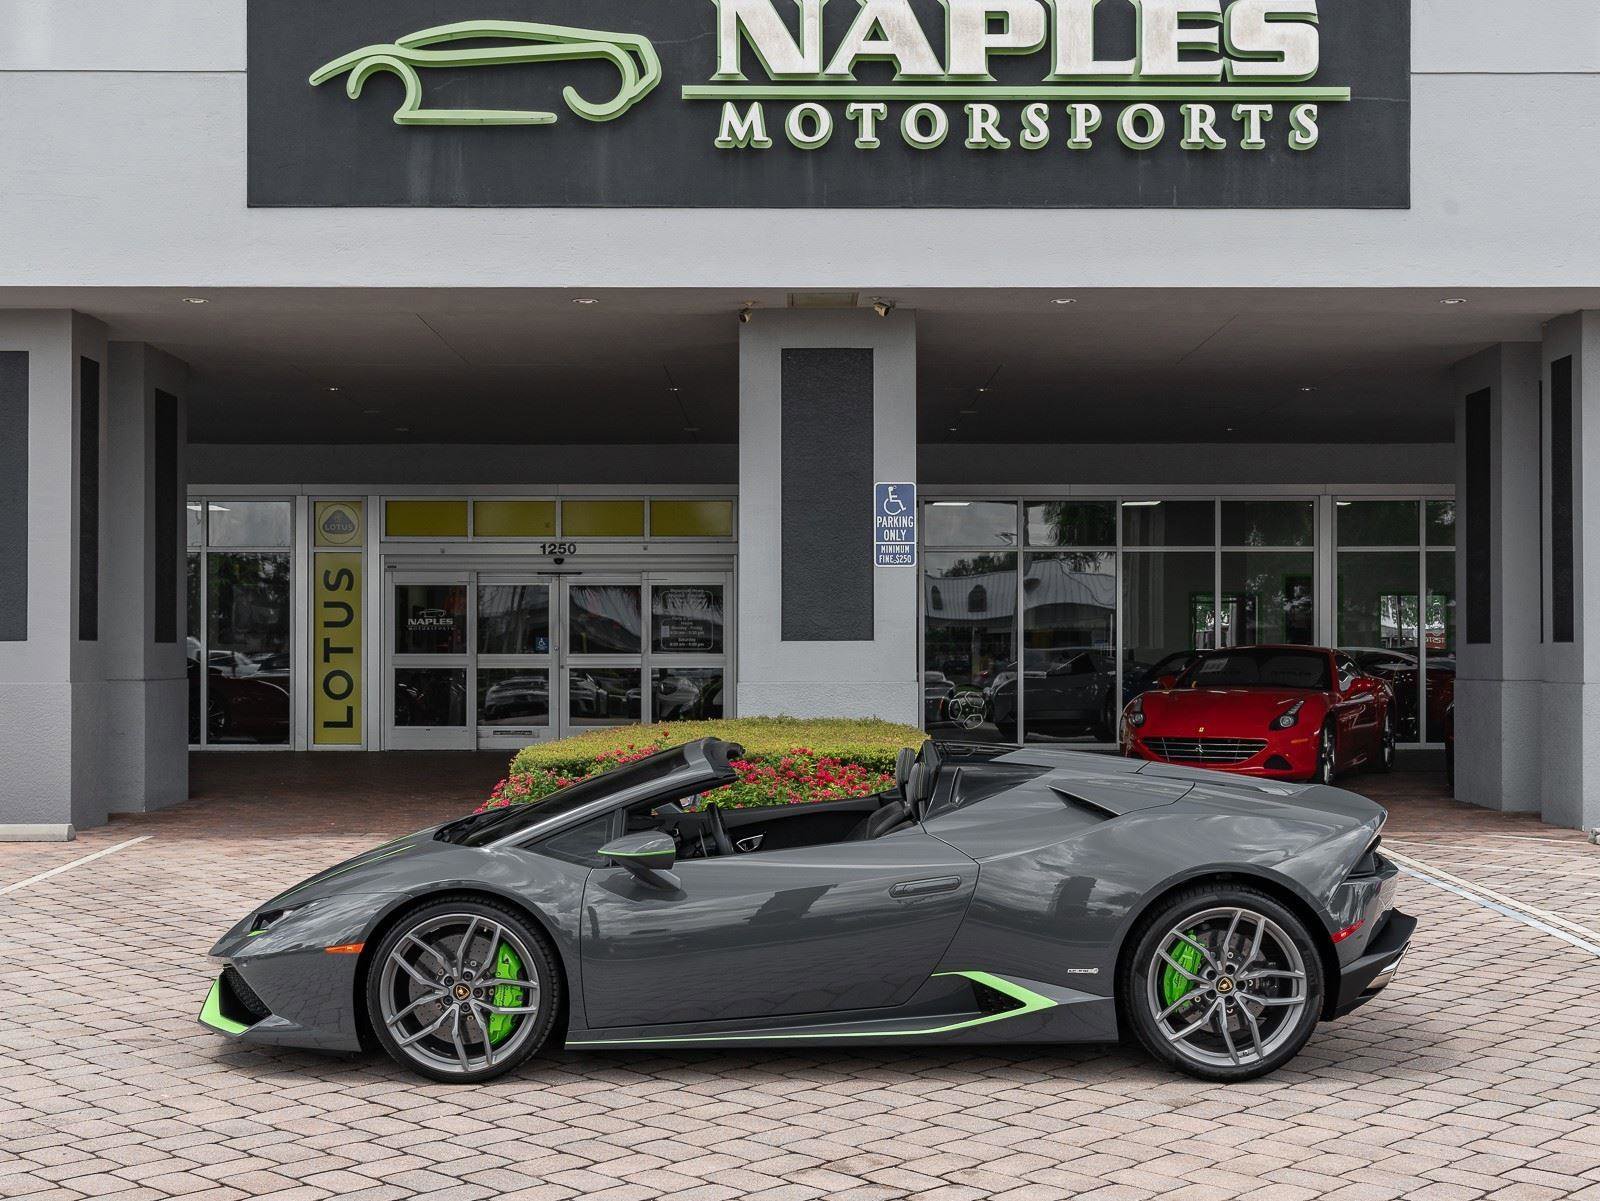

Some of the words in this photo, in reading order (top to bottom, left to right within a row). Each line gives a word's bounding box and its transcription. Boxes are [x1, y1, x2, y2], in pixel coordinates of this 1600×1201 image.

[708, 0, 1319, 82] NAPLES
[714, 101, 1319, 151] MOTORSPORTS
[877, 516, 914, 528] PARKING
[883, 529, 907, 541] ONLY
[539, 543, 577, 555] 1250
[881, 545, 910, 554] MINIMUM
[879, 555, 894, 563] FINE
[895, 554, 912, 564] $250
[407, 618, 454, 626] NAPLES
[323, 568, 354, 728] LOTUS
